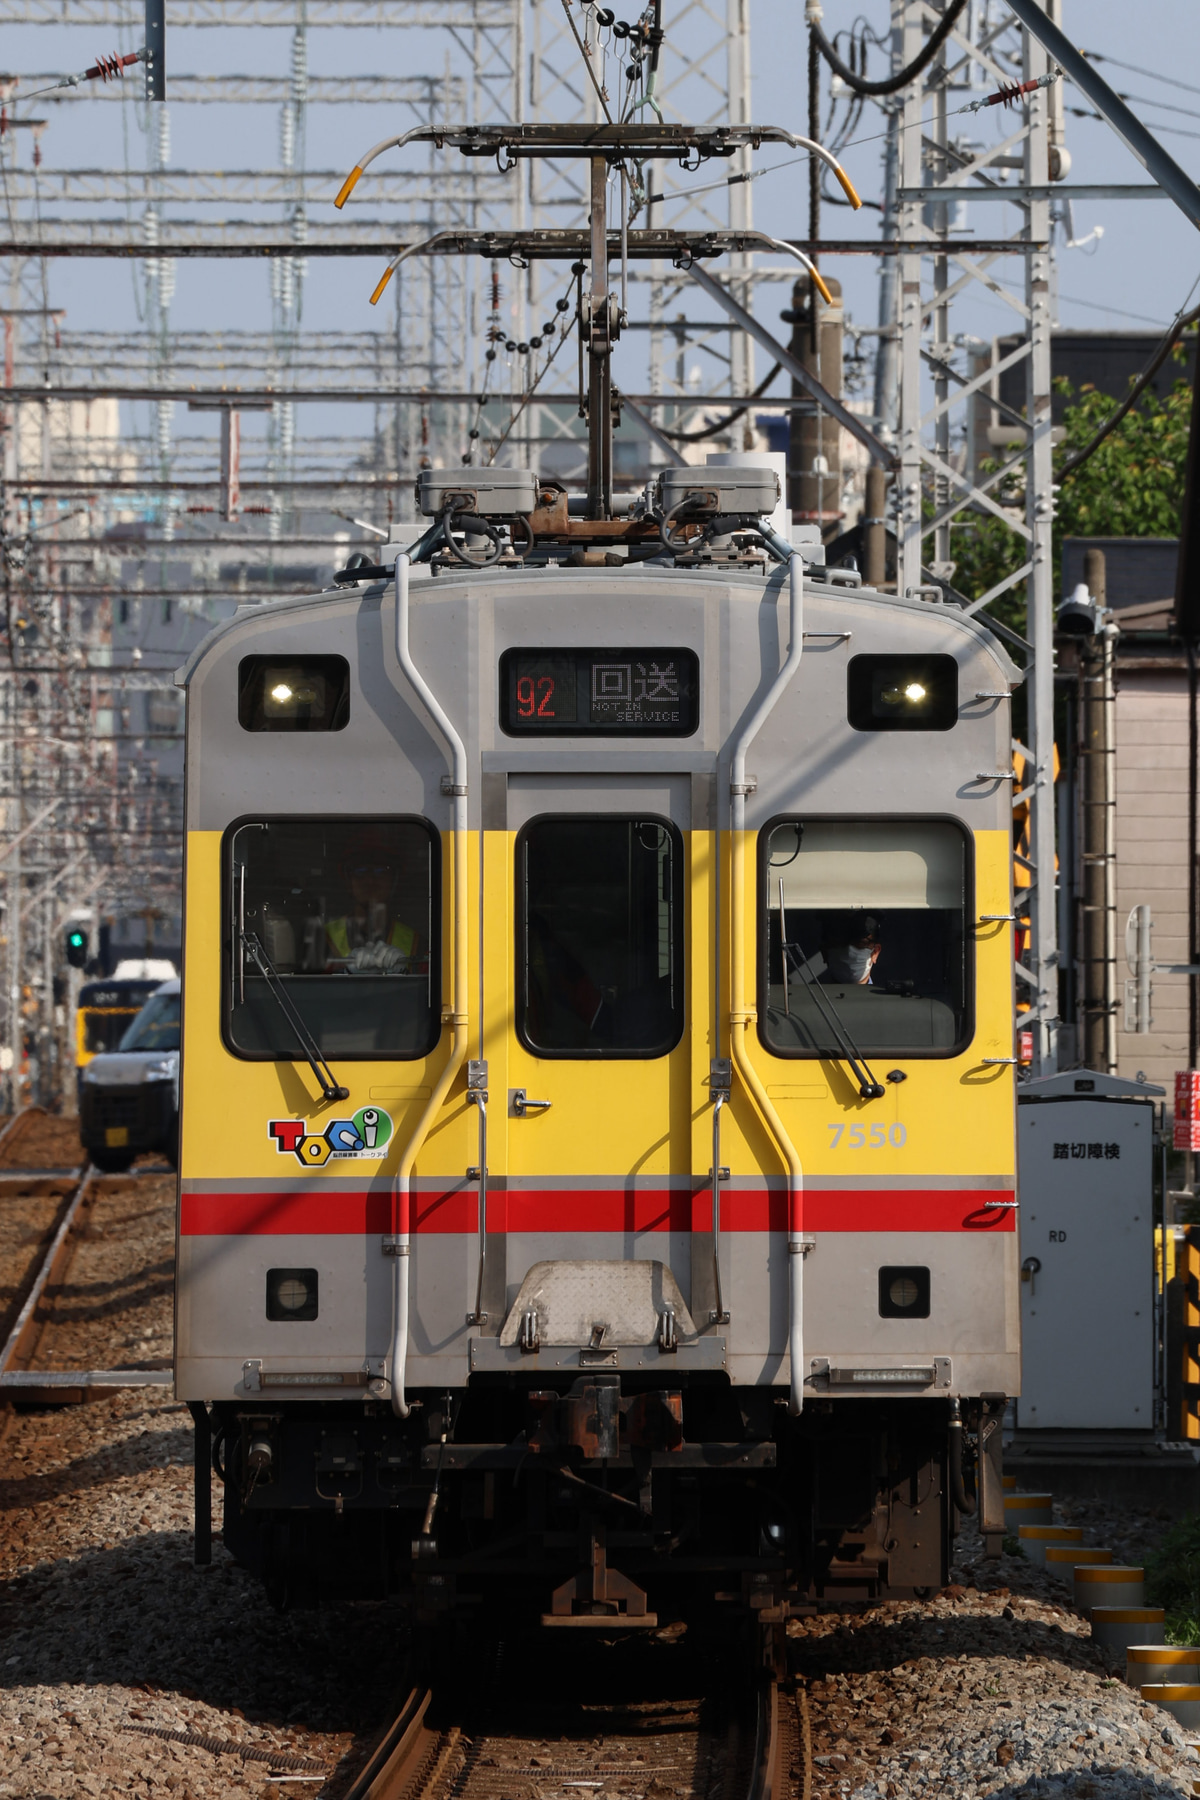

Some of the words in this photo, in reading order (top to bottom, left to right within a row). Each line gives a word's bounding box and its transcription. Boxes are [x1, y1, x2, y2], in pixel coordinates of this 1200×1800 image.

[592, 662, 680, 701] 回送
[517, 676, 555, 717] 92
[592, 702, 621, 711] NOT
[625, 702, 641, 711] IN
[616, 711, 680, 722] SERVICE
[827, 1122, 908, 1149] 7550
[1053, 1143, 1121, 1160] 踏切障検
[1049, 1231, 1067, 1242] RD
